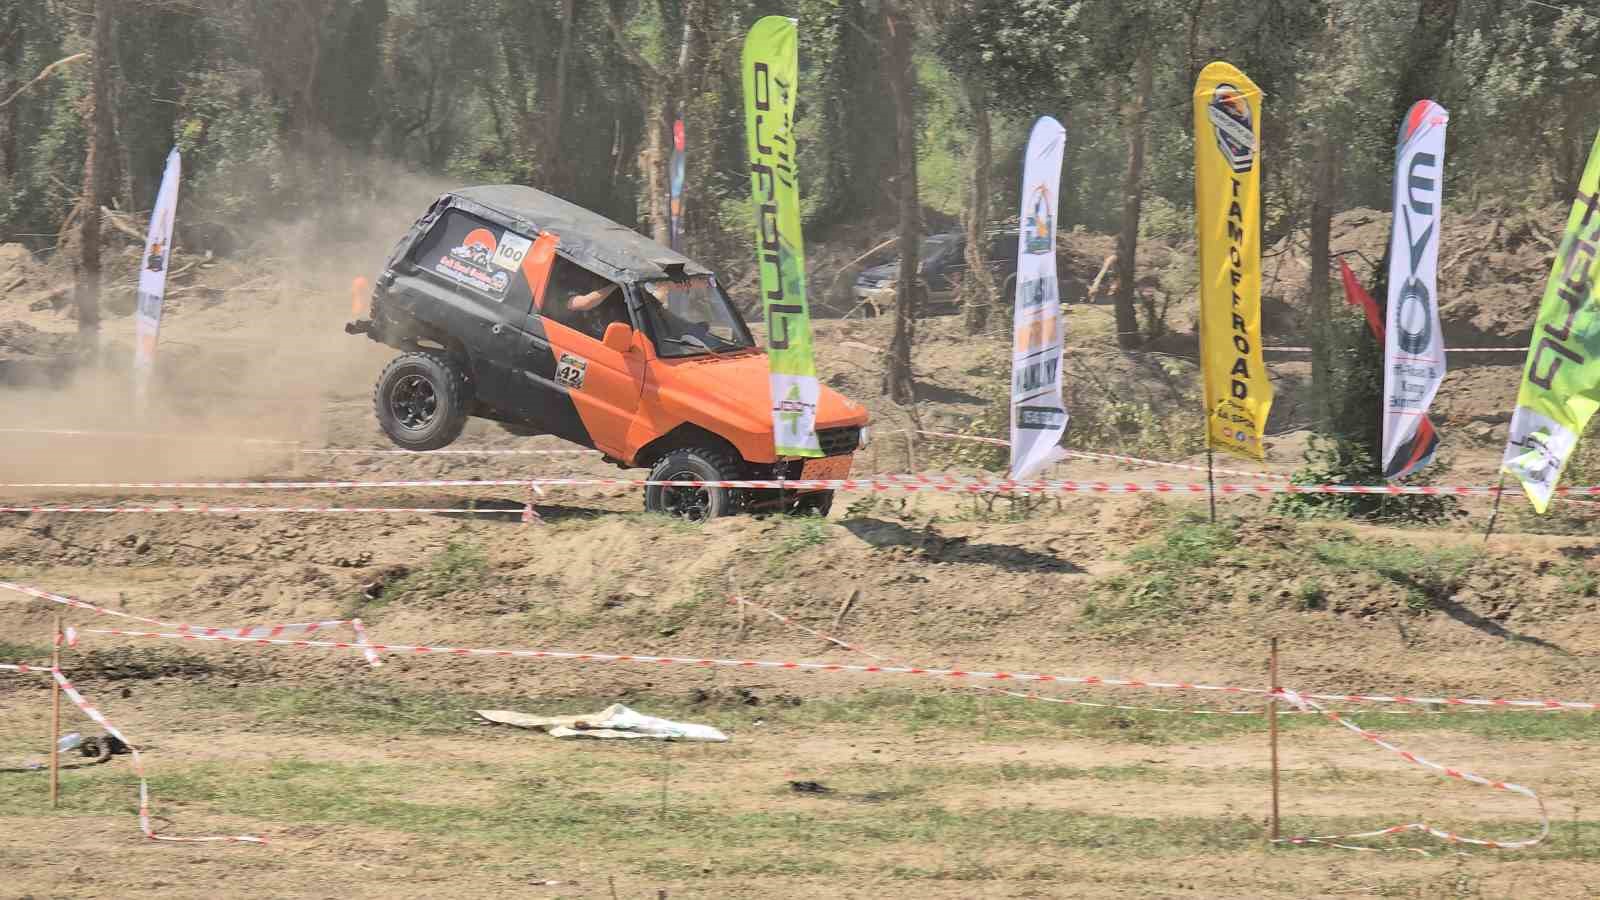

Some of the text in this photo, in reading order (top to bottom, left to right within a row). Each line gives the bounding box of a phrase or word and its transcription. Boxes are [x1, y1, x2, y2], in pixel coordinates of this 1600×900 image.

[499, 243, 523, 263] 100
[1228, 178, 1251, 399] TAMOFFROAD
[1396, 152, 1435, 354] EVO
[560, 366, 582, 383] 42
